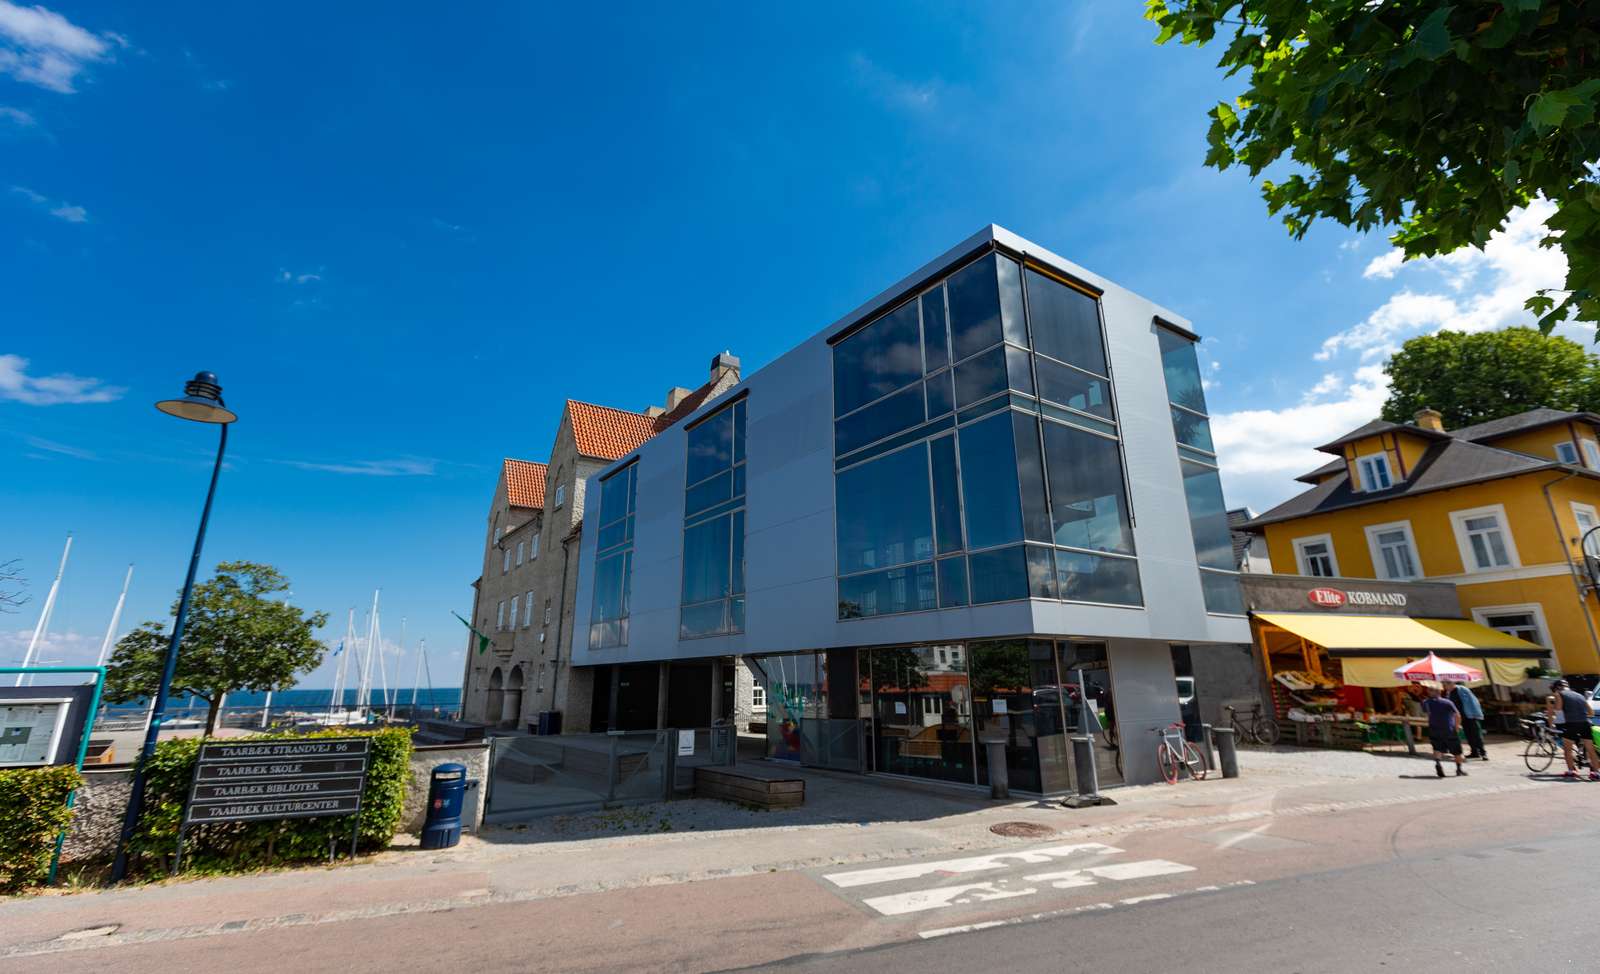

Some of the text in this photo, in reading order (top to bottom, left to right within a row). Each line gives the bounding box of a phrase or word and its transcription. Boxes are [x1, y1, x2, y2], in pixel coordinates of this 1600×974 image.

[1315, 590, 1407, 606] Elite KØBMAND
[221, 743, 348, 757] TAARBÆK STRANDVEJ 96
[216, 763, 302, 776] TAARBÆK SKOLE
[213, 782, 320, 796] TAARBÆK BIBLIOTEK
[209, 800, 339, 817] TAARBÆK KULTURCENTER
